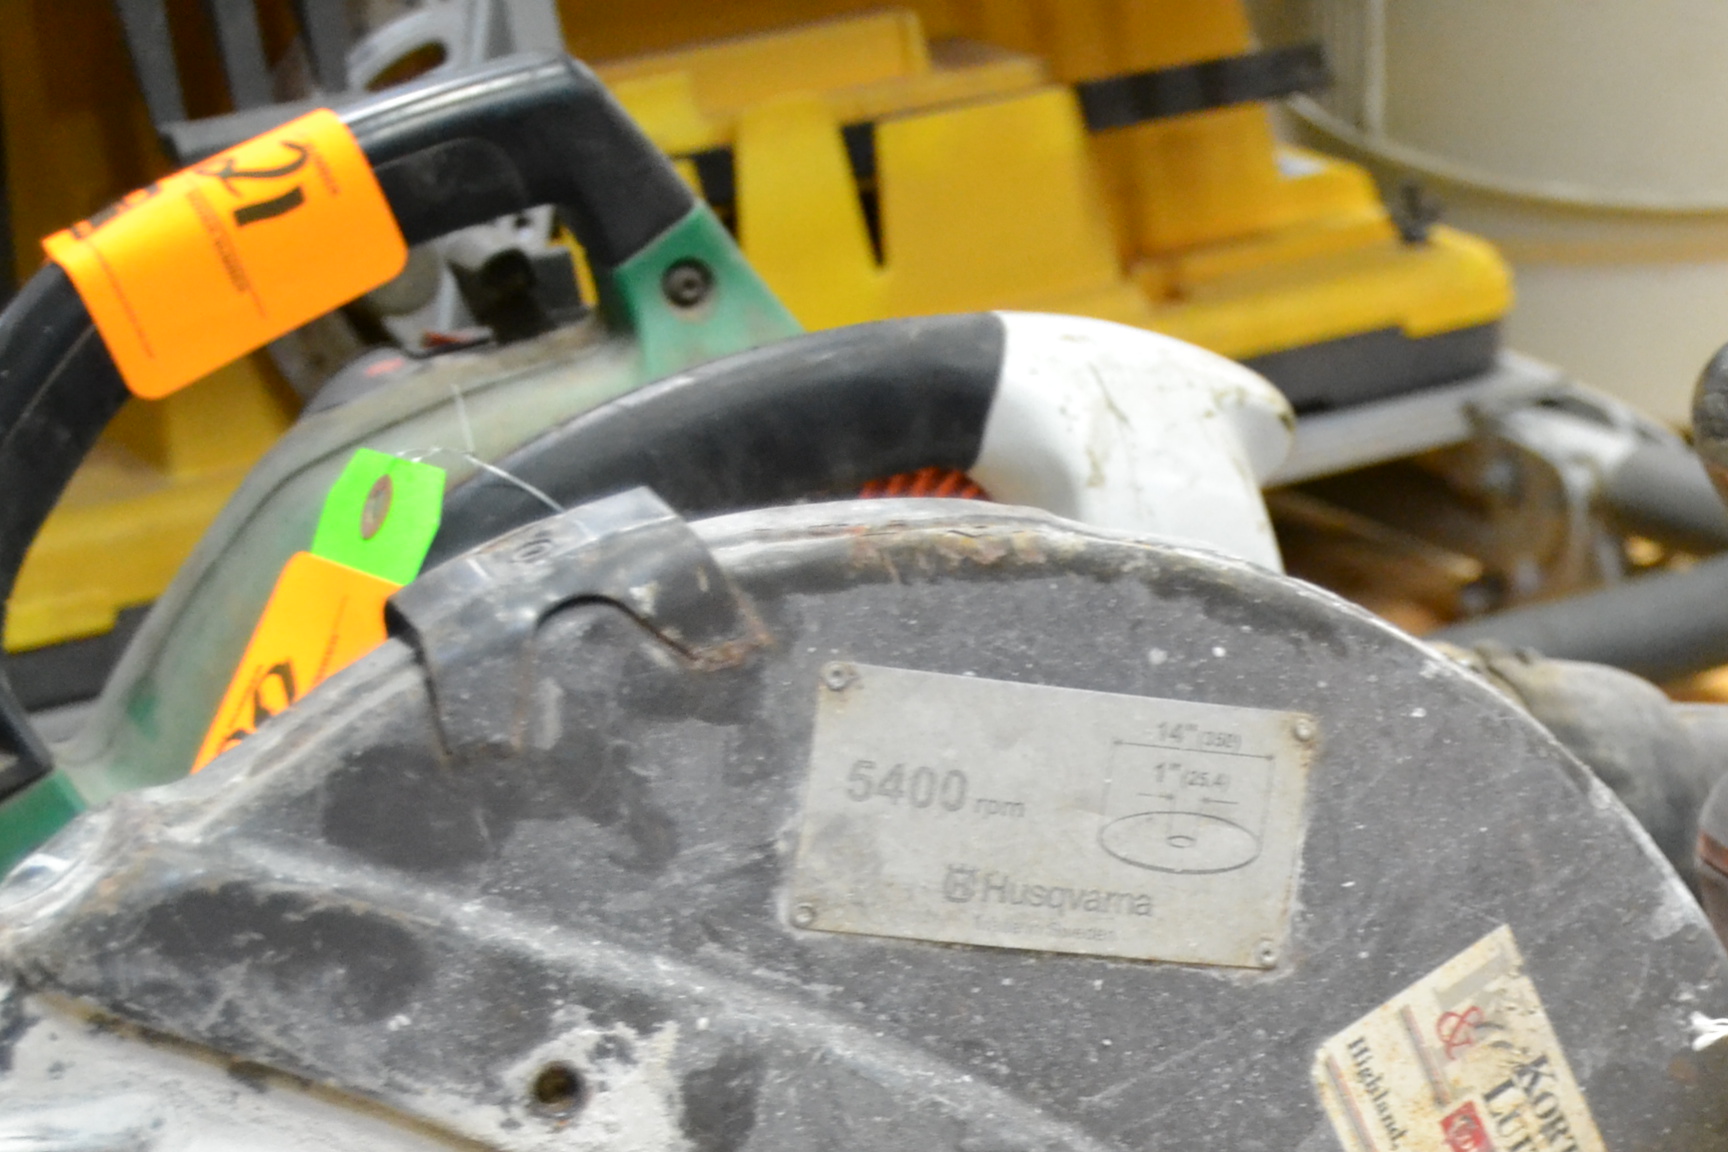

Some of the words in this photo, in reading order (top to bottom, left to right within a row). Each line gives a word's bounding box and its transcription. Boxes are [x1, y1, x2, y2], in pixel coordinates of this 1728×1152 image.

[846, 759, 969, 813] 5400
[972, 798, 1026, 820] rpm
[982, 870, 1153, 917] Husqvarna
